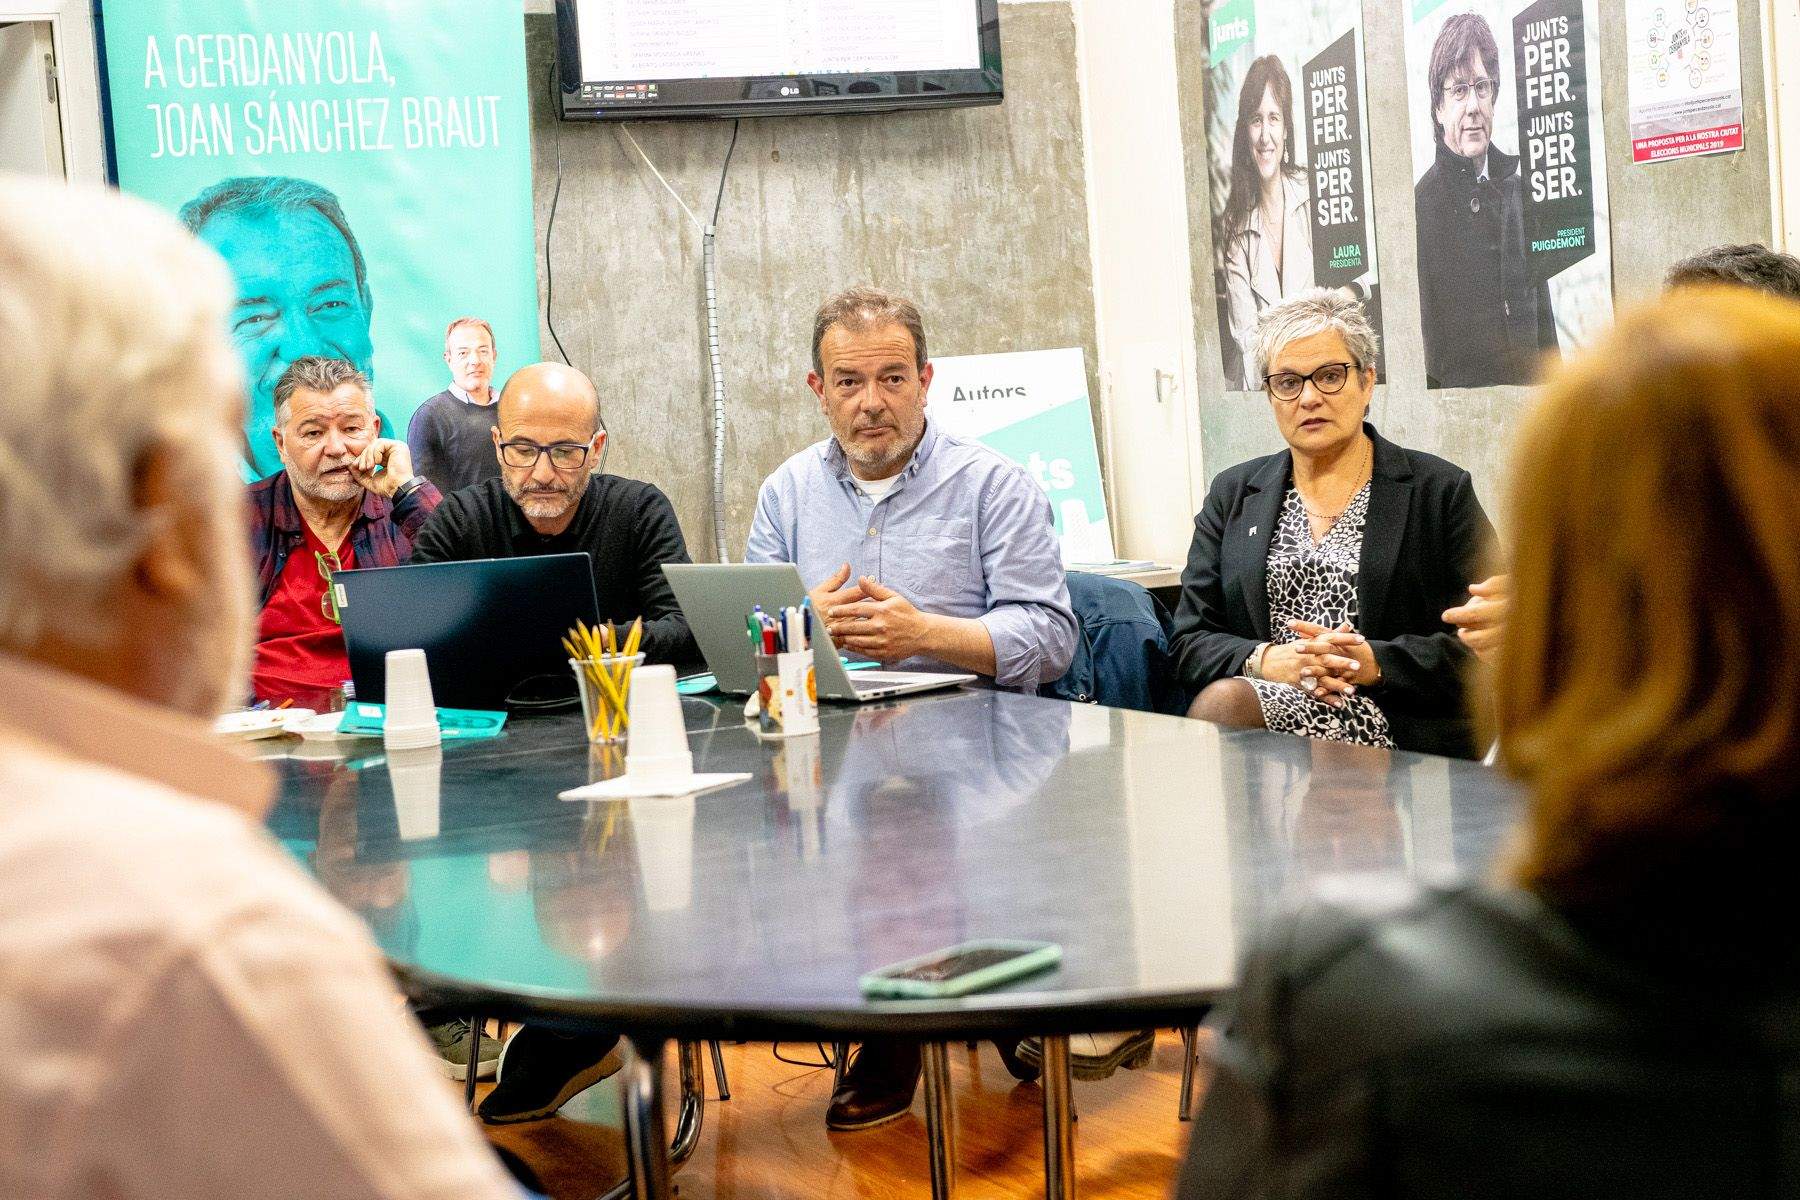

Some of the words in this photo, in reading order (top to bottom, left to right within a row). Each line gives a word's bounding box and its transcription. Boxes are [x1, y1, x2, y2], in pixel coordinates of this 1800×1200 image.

[1211, 18, 1249, 49] junts
[1522, 15, 1569, 43] JUNTS
[144, 35, 168, 89] A
[175, 31, 396, 88] CERDANYOLA,
[1523, 37, 1572, 77] PER
[1310, 65, 1346, 88] JUNTS
[1525, 71, 1576, 110] FER.
[1311, 84, 1349, 117] PER
[145, 102, 235, 159] JOAN
[243, 90, 395, 157] SÁNCHEZ
[402, 95, 502, 150] BRAUT
[1312, 114, 1353, 146] FER.
[1526, 110, 1574, 137] JUNTS
[1648, 137, 1675, 148] PROPOSTA
[1697, 130, 1720, 140] NOSTRA
[1314, 148, 1351, 170] JUNTS
[1528, 132, 1577, 170] PER
[1316, 167, 1353, 198] PER
[1530, 166, 1583, 203] SER.
[1317, 196, 1359, 227] SER.
[1532, 235, 1586, 252] PUIGDEMONT
[1557, 227, 1585, 238] PRESIDENT
[1329, 258, 1362, 269] PRESIDENTA
[1333, 244, 1361, 259] LAURA
